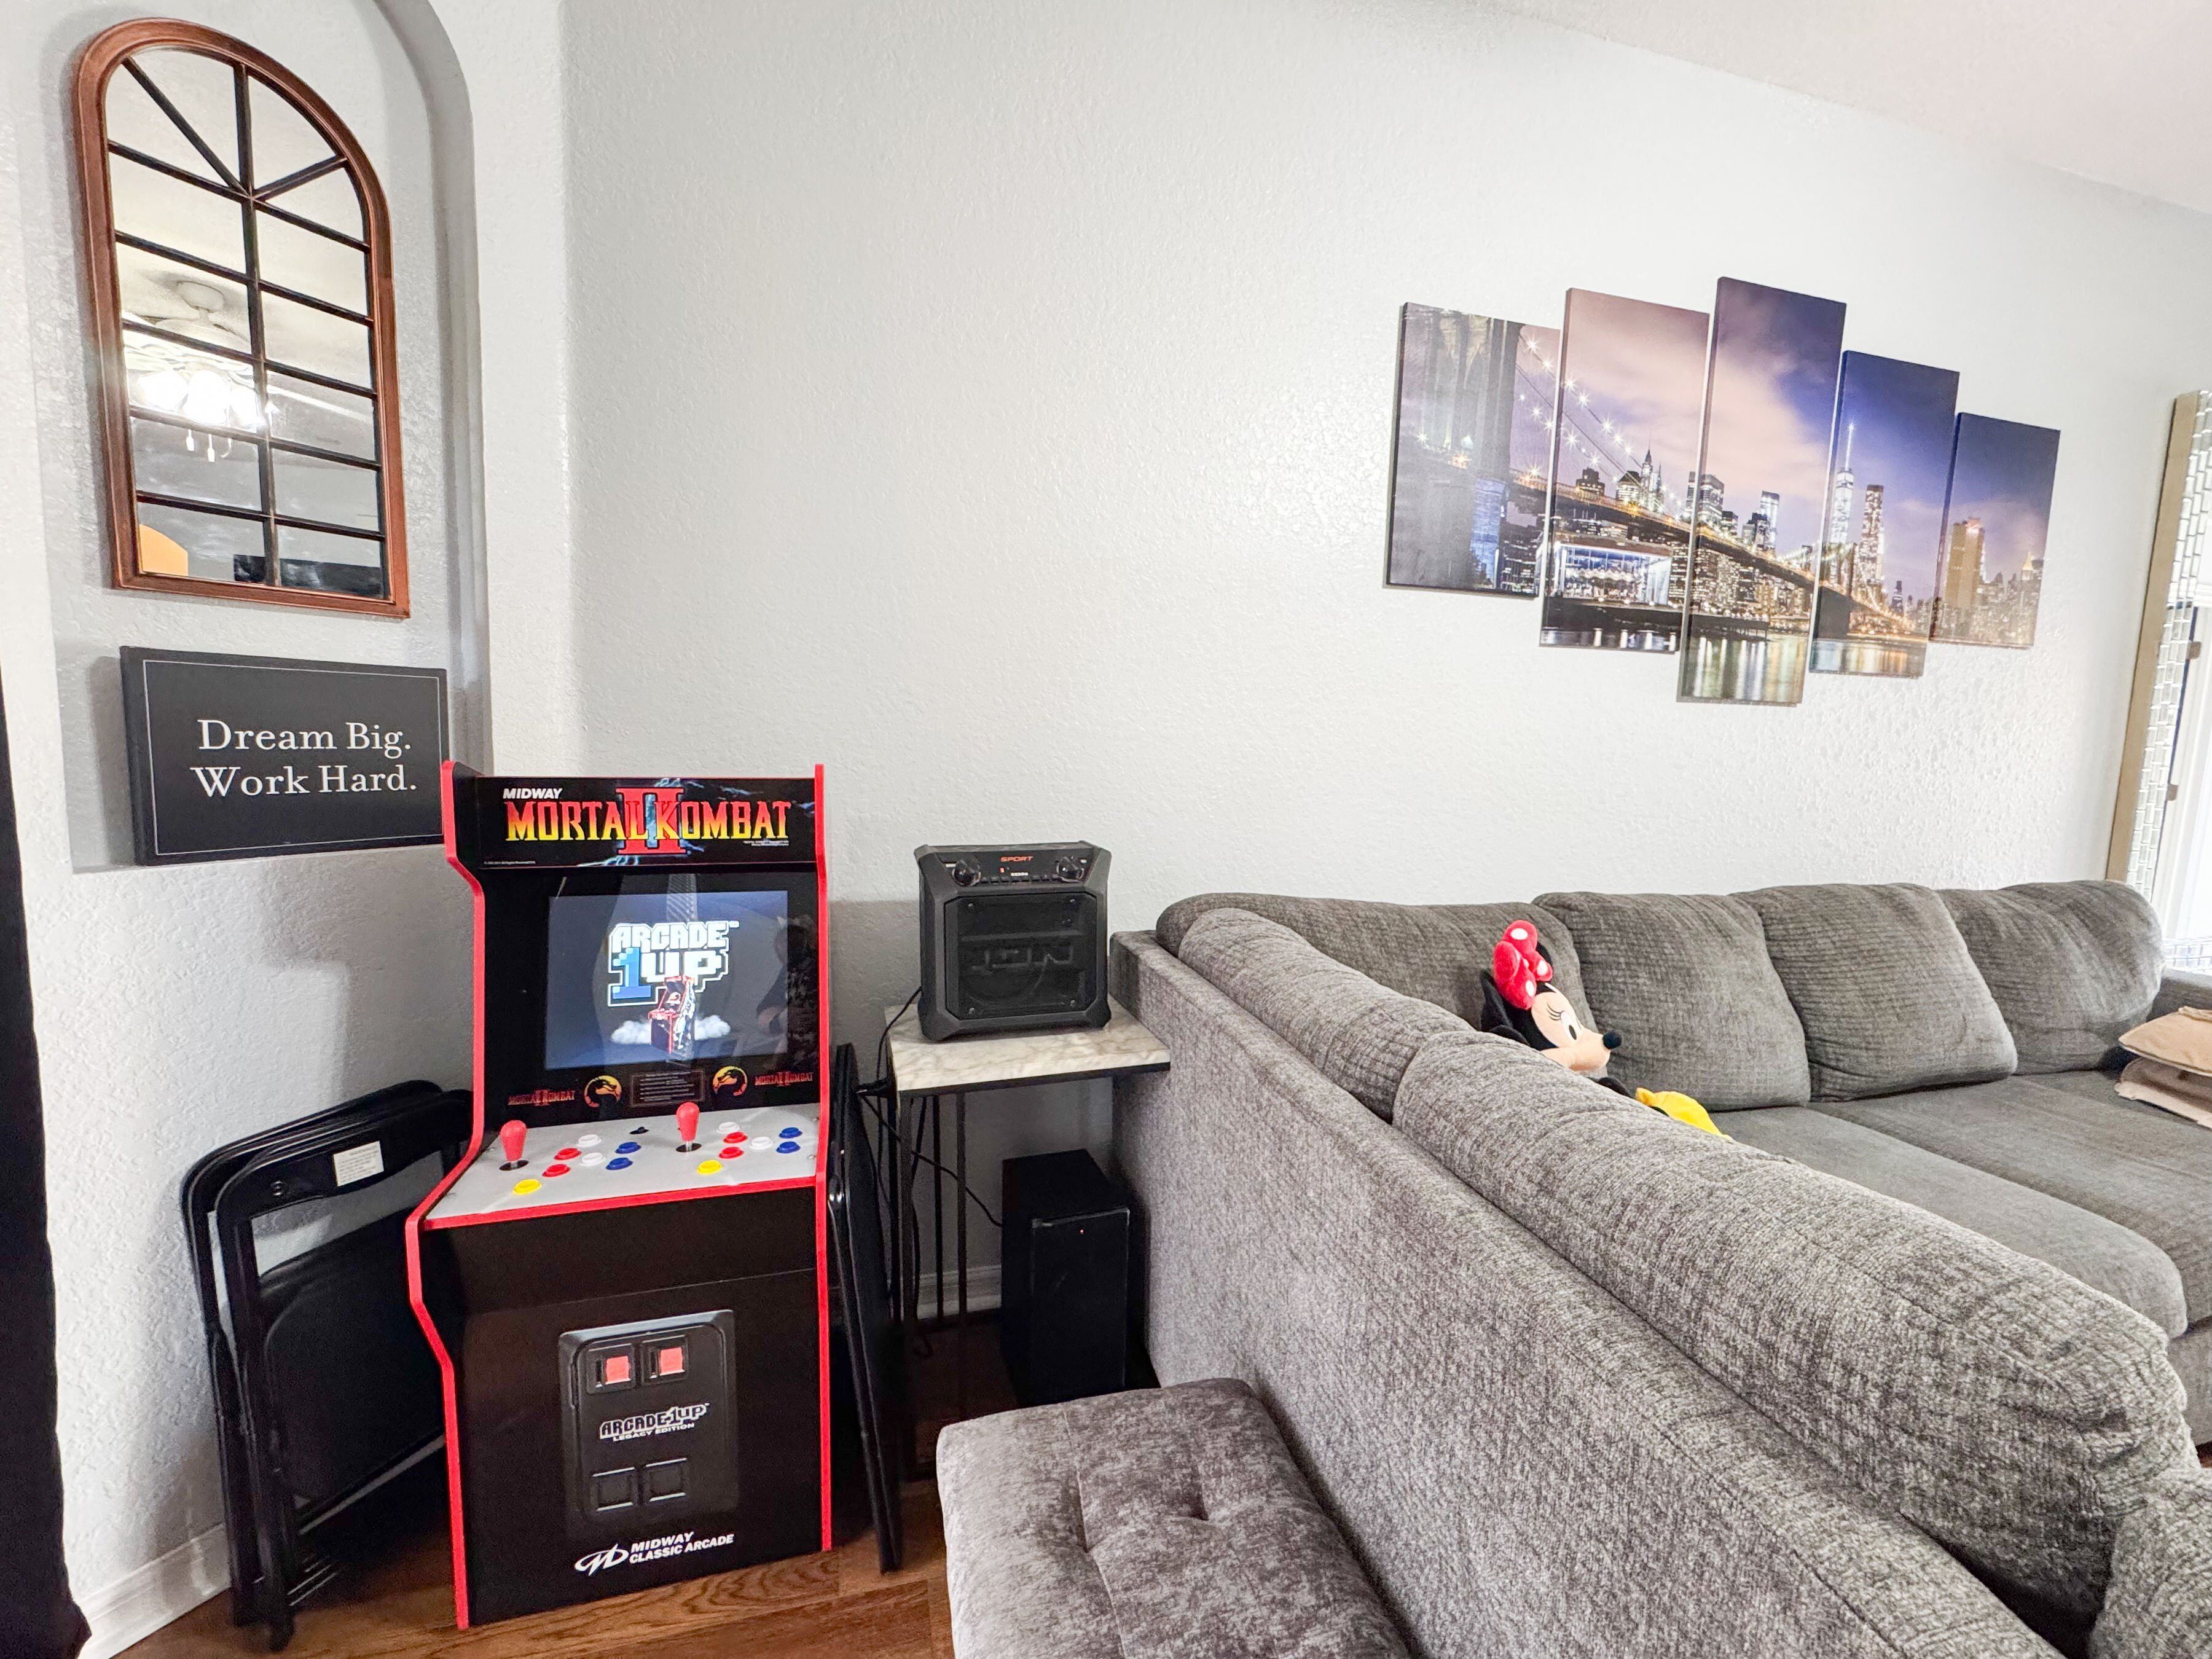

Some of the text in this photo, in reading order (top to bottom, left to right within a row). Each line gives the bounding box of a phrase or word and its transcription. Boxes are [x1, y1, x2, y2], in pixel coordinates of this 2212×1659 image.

[197, 719, 412, 759] Dream Big.
[190, 764, 418, 797] Work Hard.
[503, 788, 563, 799] MIDWAY
[504, 801, 791, 841] MORTAL KOMBAT
[611, 923, 727, 953] ARCADE
[612, 947, 723, 1000] 1UP
[613, 1422, 695, 1442] LEGACY EDITION
[629, 1534, 735, 1564] CLASSIC ARCADE
[630, 1532, 694, 1553] MIDWAY
